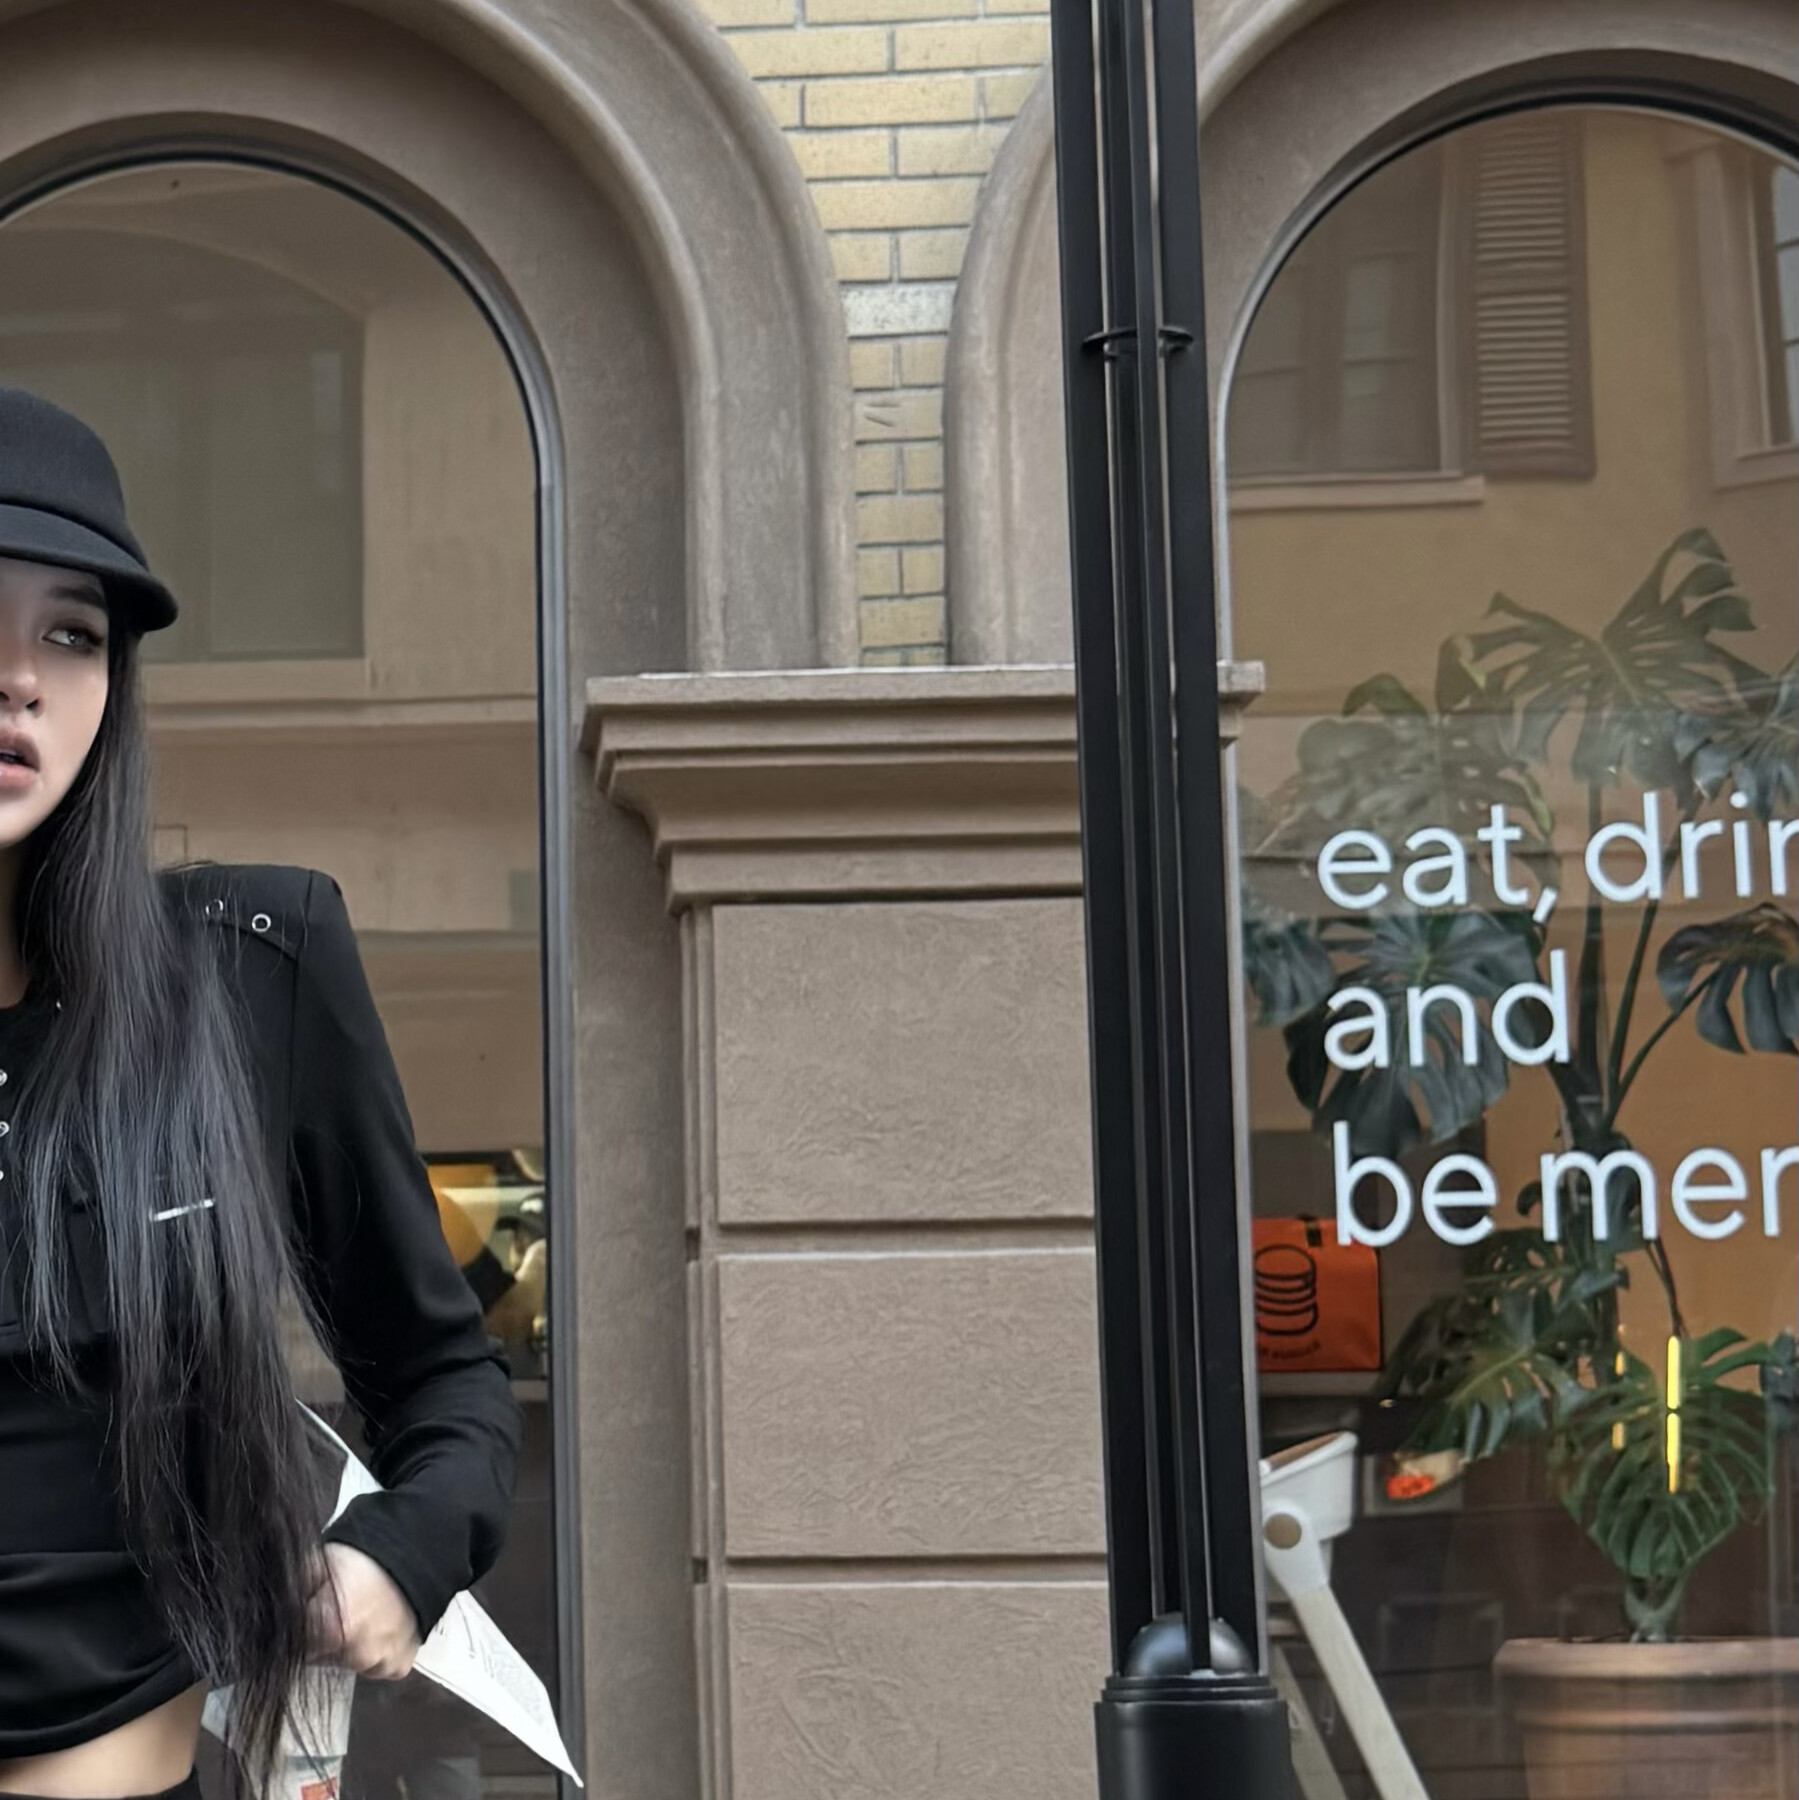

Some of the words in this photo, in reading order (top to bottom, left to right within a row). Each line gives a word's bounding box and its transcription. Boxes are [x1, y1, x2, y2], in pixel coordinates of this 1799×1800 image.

[1317, 804, 1557, 923] eat,
[1323, 949, 1570, 1070] and
[1333, 1120, 1498, 1246] be
[1539, 1146, 1799, 1241] mer
